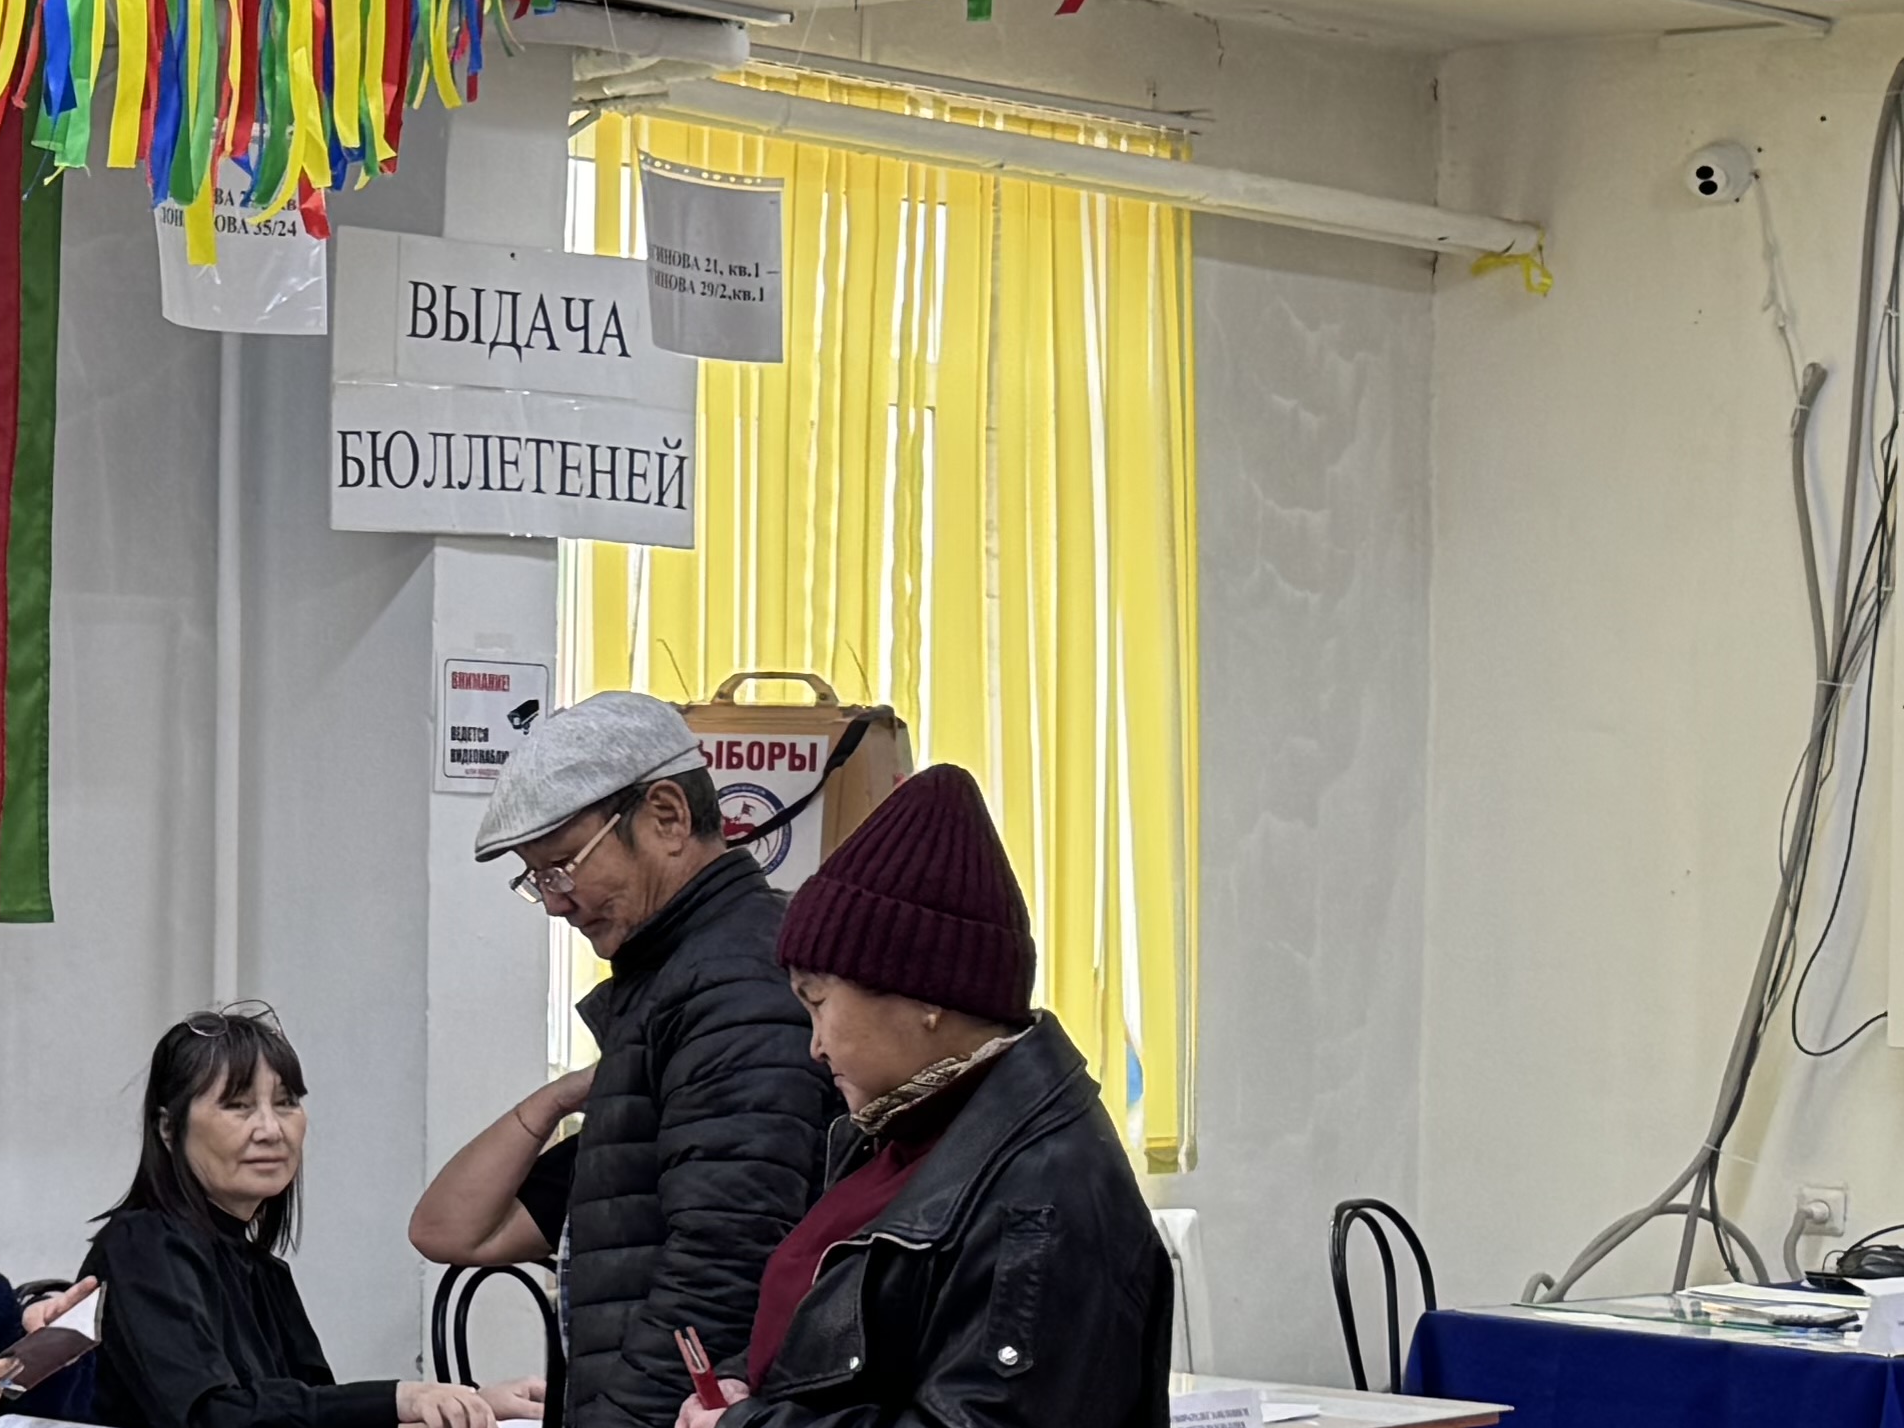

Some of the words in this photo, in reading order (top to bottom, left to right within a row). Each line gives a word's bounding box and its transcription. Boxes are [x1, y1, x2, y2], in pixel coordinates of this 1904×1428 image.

[407, 279, 632, 362] ВЫДАЧА
[337, 429, 689, 511] БЮЛЛЕТЕНЕЙ
[698, 739, 817, 772] ЫБОРЫ
